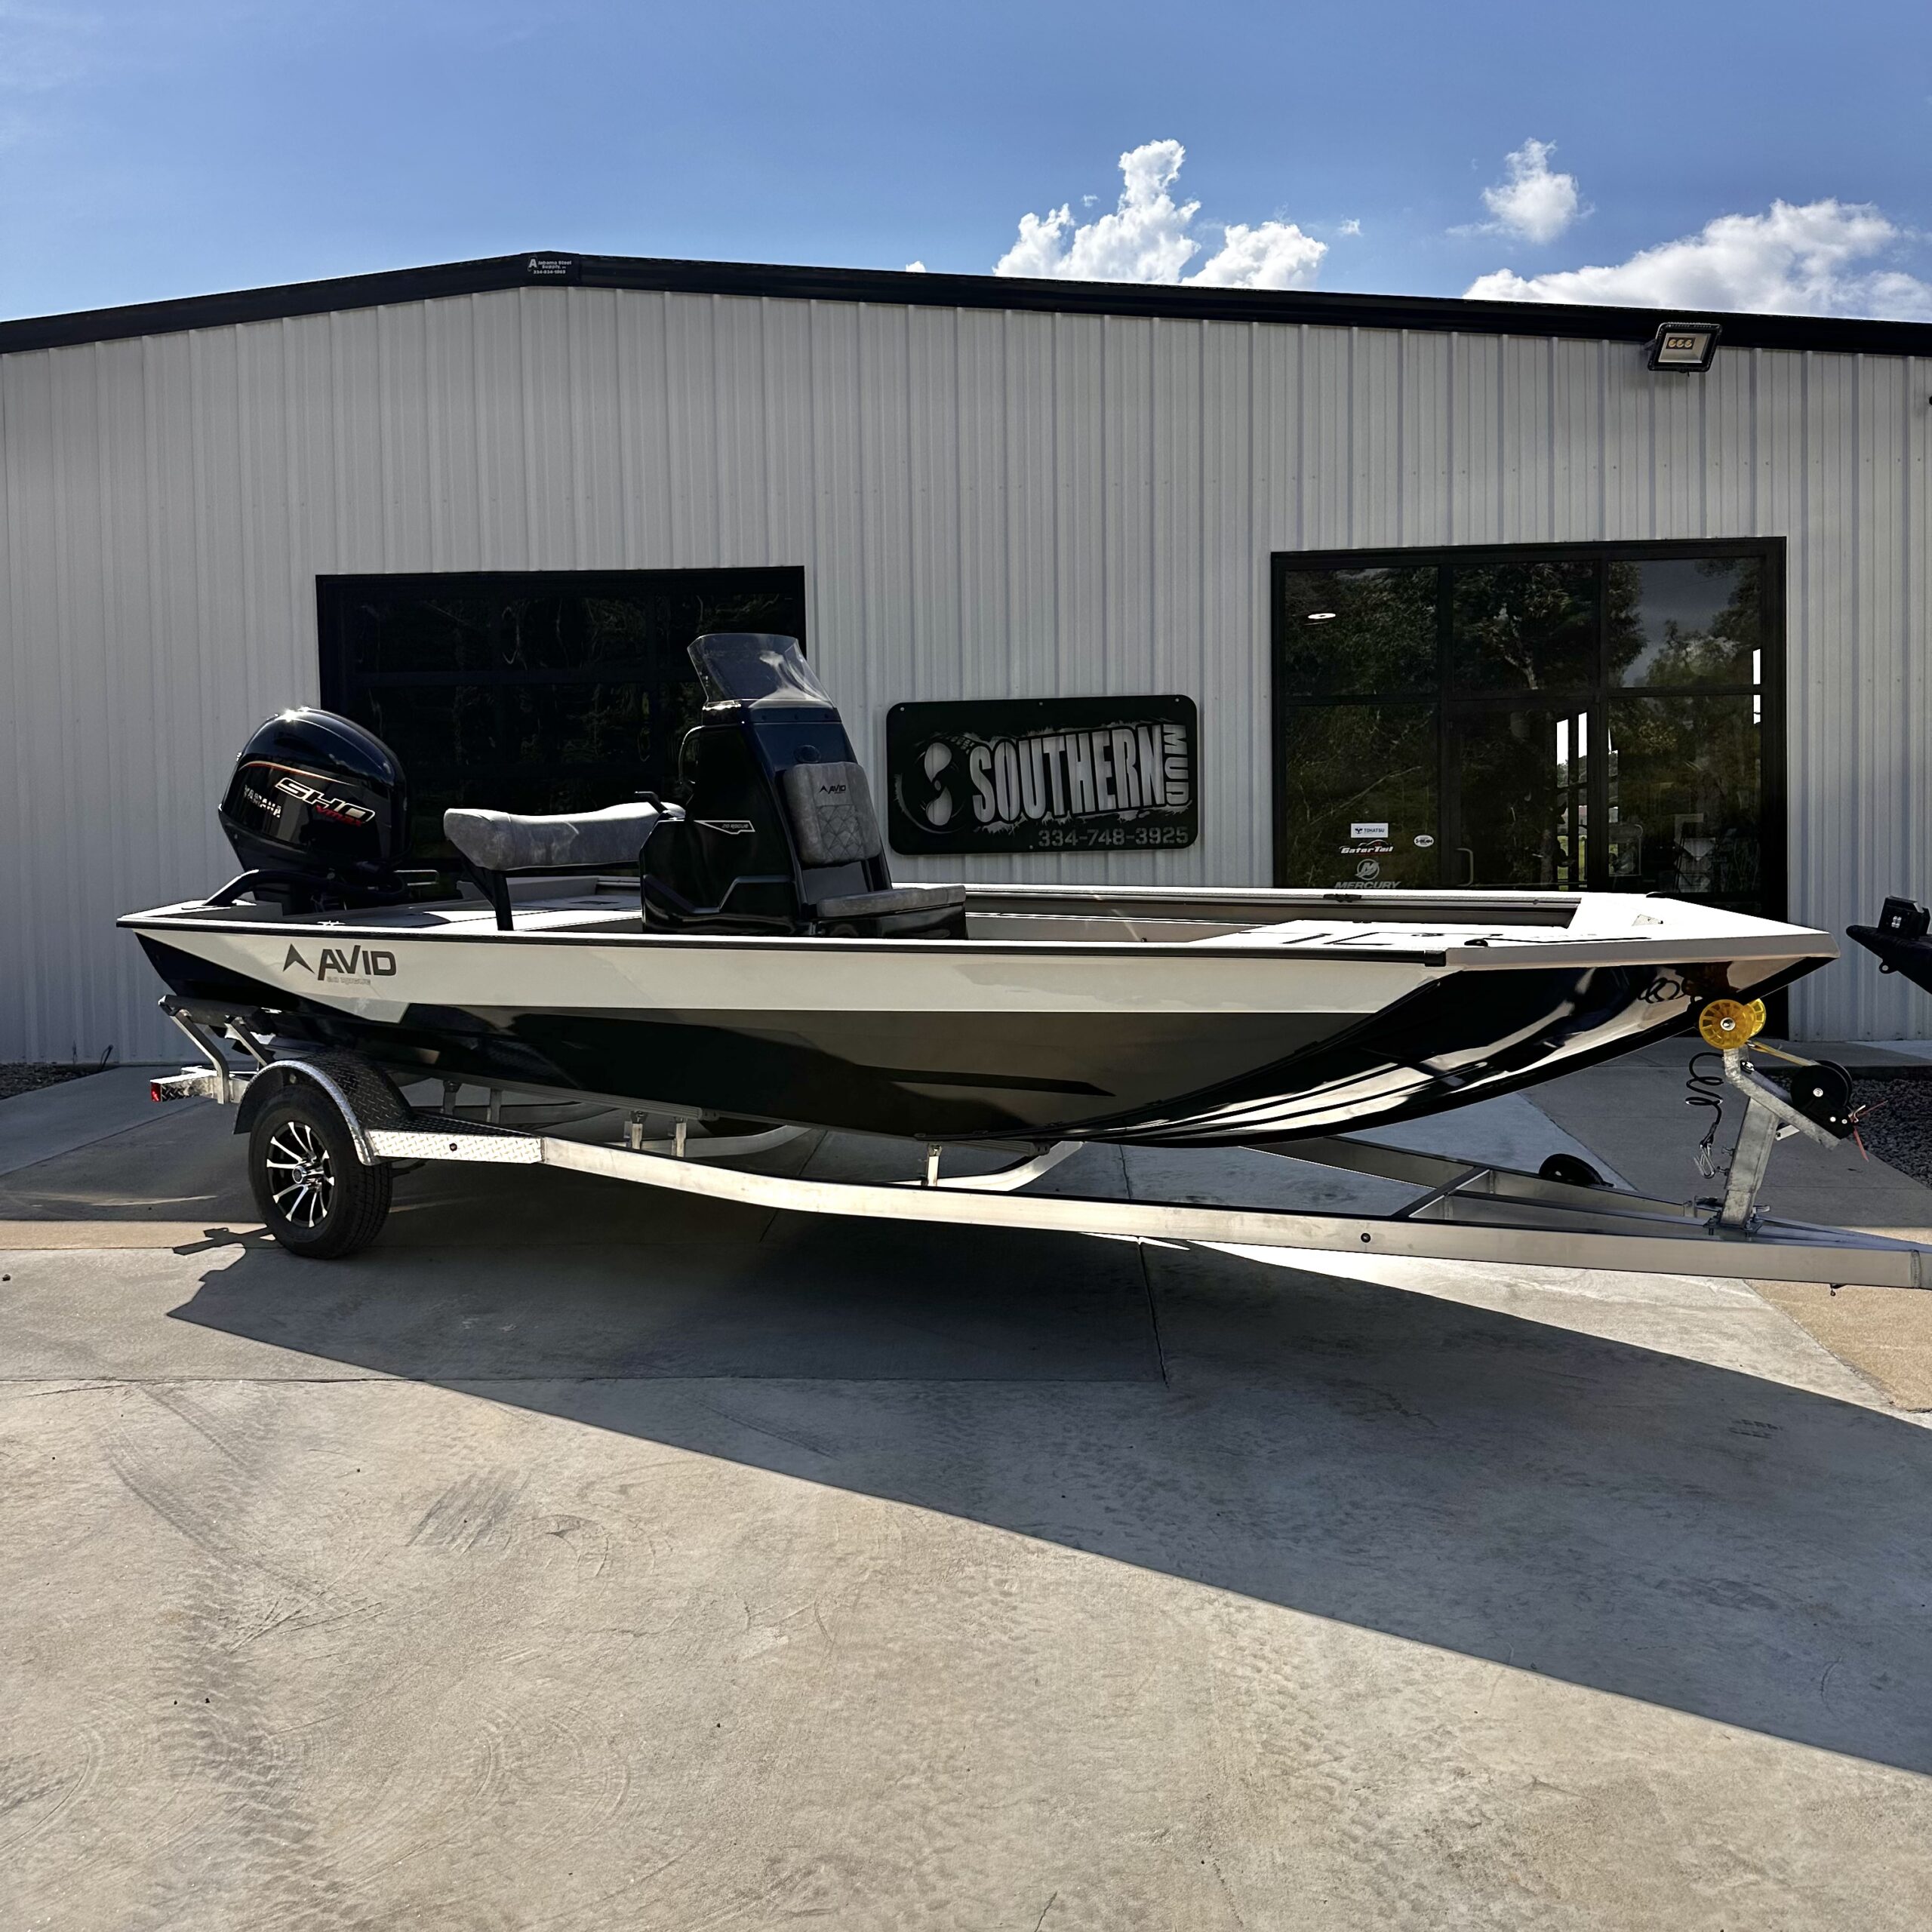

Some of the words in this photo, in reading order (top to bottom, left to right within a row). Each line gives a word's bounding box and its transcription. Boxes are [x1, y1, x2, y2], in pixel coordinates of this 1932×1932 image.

[970, 724, 1165, 823] SOUTHERN
[1163, 724, 1190, 805] MUD
[244, 784, 282, 819] YAMAHA
[274, 777, 376, 824] SHO
[828, 784, 846, 794] AVID
[1038, 826, 1189, 847] 334-748-3925
[1334, 881, 1401, 889] MERCURY
[318, 945, 397, 981] AVID
